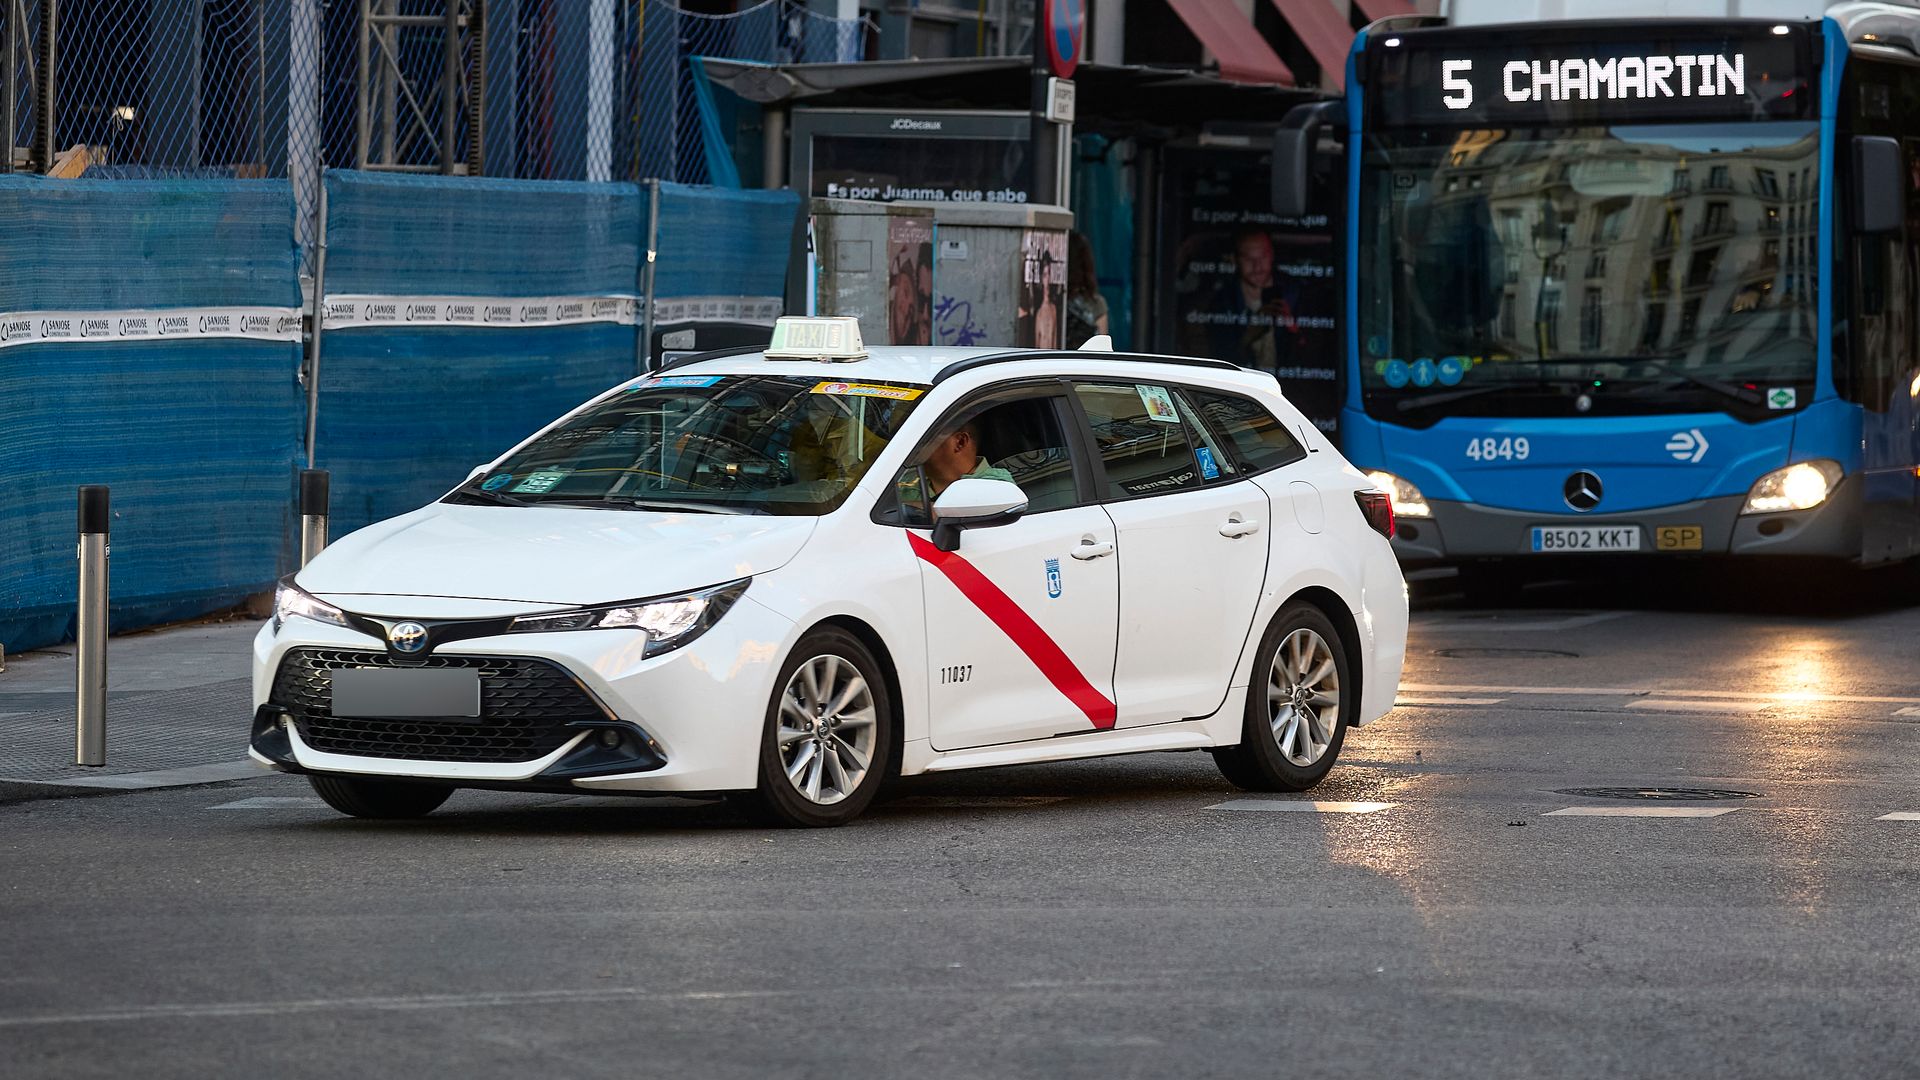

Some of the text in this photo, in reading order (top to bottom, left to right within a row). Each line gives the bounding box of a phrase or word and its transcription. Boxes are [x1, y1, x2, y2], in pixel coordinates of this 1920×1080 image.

[1442, 54, 1745, 109] 5 CHAMARTIN
[890, 118, 942, 130] JCDecaux
[827, 182, 848, 199] Es
[851, 187, 880, 200] por
[952, 187, 983, 201] que
[986, 187, 1028, 203] sabe
[330, 303, 355, 314] SANJOSE
[373, 304, 396, 314] SANJOSE
[414, 305, 436, 314] SANJOSE
[49, 319, 70, 330] SANJOSE
[88, 319, 109, 330] SANJOSE
[127, 318, 148, 328] SANJOSE
[165, 316, 188, 327] SANJOSE
[208, 315, 230, 326] SANJOSE
[248, 315, 270, 326] SANJOSE
[9, 320, 31, 333] SANJOSE
[789, 324, 824, 347] TAXI
[1465, 436, 1530, 461] 4849
[1543, 529, 1634, 549] 8502 KKT
[1662, 529, 1696, 548] SP
[941, 664, 973, 684] 11037
